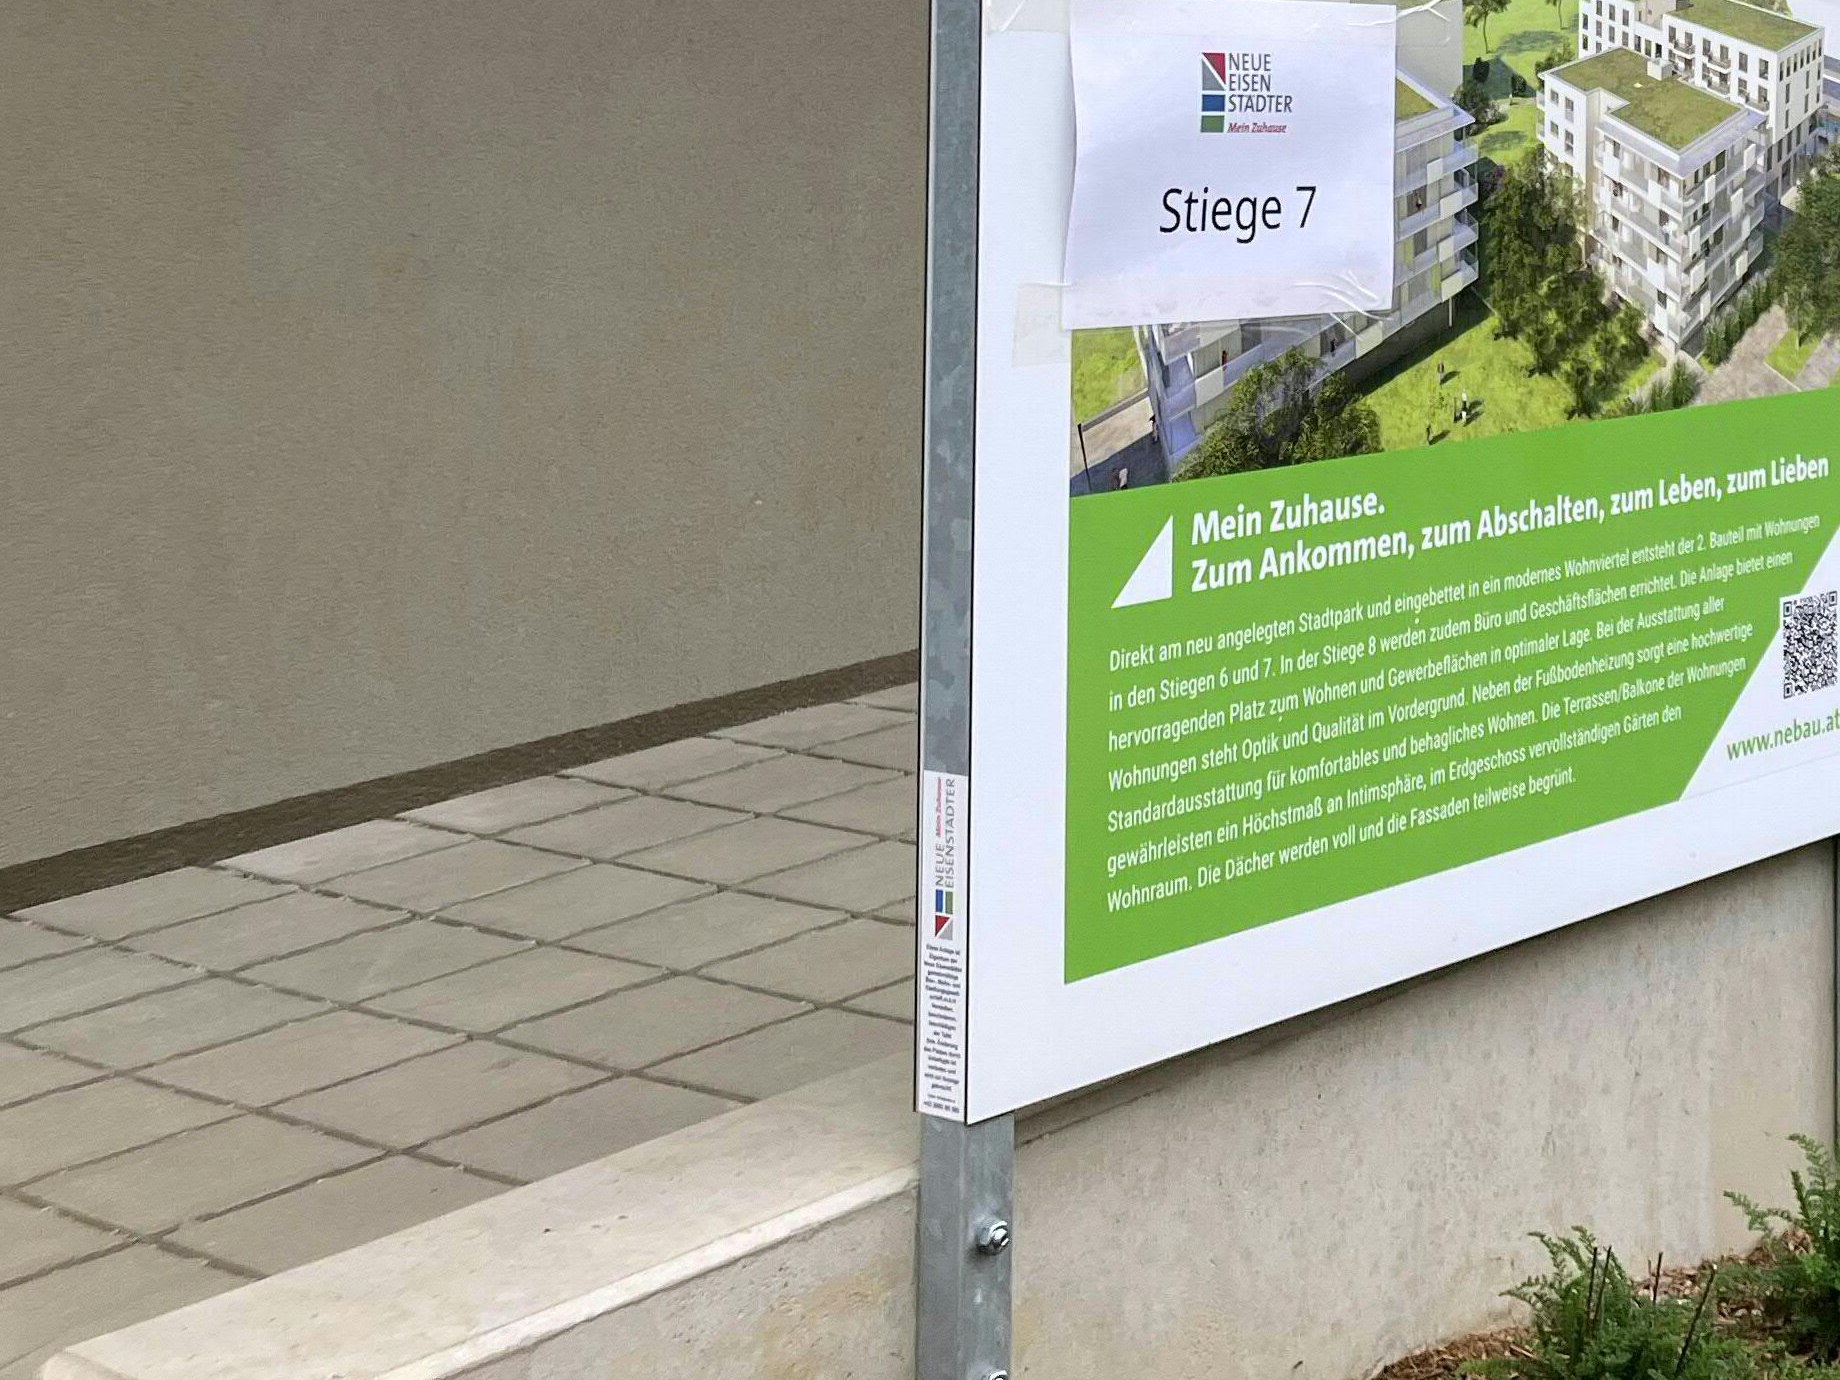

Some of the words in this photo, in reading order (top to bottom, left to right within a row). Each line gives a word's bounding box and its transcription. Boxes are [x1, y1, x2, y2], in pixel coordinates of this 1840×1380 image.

[1228, 53, 1271, 72] NEUE
[1228, 74, 1271, 92] EISEN
[1228, 95, 1293, 113] STÄDTER
[1159, 187, 1282, 244] Stiege
[1296, 185, 1317, 229] 7
[1191, 503, 1262, 545] Mein
[1269, 492, 1385, 532] Zuhause.
[1191, 558, 1252, 592] Zum
[1258, 531, 1415, 580] Ankommen,
[1421, 519, 1471, 550] zum
[1476, 495, 1605, 540] Abschalten,
[1610, 487, 1653, 515] zum
[1658, 475, 1722, 506] Leben,
[1726, 467, 1766, 494] zum
[1771, 456, 1829, 486] Lieben
[1109, 643, 1154, 671] Direkt
[1159, 642, 1182, 662] am
[1186, 636, 1213, 656] neu
[1217, 619, 1295, 651] angelegten
[1298, 601, 1364, 632] Stadtpark
[1366, 594, 1391, 618] und
[1394, 582, 1465, 614] eingebettet
[1468, 581, 1479, 597] in
[1482, 575, 1501, 595] ein
[1503, 565, 1561, 590] modernes
[1564, 548, 1630, 577] Wohnviertel
[1631, 540, 1675, 564] entsteht
[1677, 537, 1695, 555] der
[1709, 526, 1744, 549] Bauteil
[1746, 523, 1763, 541] mit
[1764, 514, 1820, 537] Wohnungen
[1109, 693, 1123, 711] in
[1127, 685, 1155, 708] den
[1160, 674, 1215, 700] Stiegen
[1219, 667, 1228, 688] 6
[1232, 659, 1259, 684] und
[1280, 655, 1293, 674] In
[1296, 649, 1320, 671] der
[1322, 642, 1365, 665] Stiege
[1368, 635, 1376, 656] 8
[1379, 627, 1426, 652] werden
[1429, 618, 1471, 642] zudem
[1474, 611, 1502, 632] Büro
[1504, 603, 1527, 625] und
[1529, 584, 1627, 620] Geschäftsflächen
[1629, 574, 1677, 598] errichtet.
[1680, 569, 1697, 587] Die
[1698, 563, 1735, 583] Anlage
[1736, 555, 1764, 575] bietet
[1766, 551, 1793, 568] einen
[1108, 708, 1225, 751] hervorragenden
[1229, 700, 1266, 723] Platz
[1269, 693, 1299, 715] zum
[1302, 680, 1356, 707] Wohnen
[1360, 669, 1384, 694] und
[1388, 650, 1487, 687] Gewerbeflächen
[1490, 648, 1502, 664] in
[1504, 632, 1560, 663] optimaler
[1562, 627, 1593, 648] Lage.
[1596, 620, 1614, 639] Bei
[1616, 615, 1635, 634] der
[1636, 603, 1701, 629] Ausstattung
[1702, 595, 1725, 615] aller
[1108, 755, 1196, 792] Wohnungen
[1201, 743, 1238, 769] steht
[1241, 732, 1279, 762] Optik
[1282, 724, 1308, 750] und
[1312, 713, 1364, 743] Qualität
[1367, 710, 1384, 728] im
[1387, 687, 1468, 723] Vordergrund.
[1472, 680, 1510, 704] Neben
[1513, 674, 1533, 693] der
[1535, 651, 1634, 688] Fußbodenheizung
[1636, 641, 1664, 663] sorgt
[1666, 638, 1689, 656] eine
[1690, 623, 1753, 649] hochwertige
[1727, 708, 1840, 761] www.nebau.at
[1107, 779, 1262, 832] Standardausstattung
[1266, 769, 1286, 791] für
[1289, 747, 1379, 786] komfortables
[1382, 737, 1407, 762] und
[1410, 722, 1484, 755] behagliches
[1487, 709, 1538, 734] Wohnen.
[1541, 701, 1560, 721] Die
[1563, 677, 1665, 714] Terrassen/Balkone
[1666, 672, 1684, 689] der
[1686, 657, 1746, 683] Wohnungen
[1107, 830, 1212, 877] gewährleisten
[1216, 821, 1238, 843] ein
[1242, 795, 1323, 836] Höchstmaß
[1326, 795, 1343, 814] an
[1346, 773, 1426, 808] Intimsphäre,
[1430, 768, 1445, 786] im
[1449, 747, 1526, 781] Erdgeschoss
[1528, 721, 1621, 758] vervollständigen
[1623, 711, 1659, 733] Gärten
[1661, 705, 1681, 723] den
[935, 844, 944, 886] NEUE
[1107, 875, 1192, 912] Wohnraum.
[1197, 864, 1221, 887] Die
[1225, 851, 1275, 880] Dächer
[1278, 836, 1328, 865] werden
[1332, 824, 1355, 849] voll
[1359, 816, 1383, 842] und
[1386, 813, 1407, 834] die
[1410, 797, 1470, 828] Fassaden
[1473, 782, 1526, 810] teilweise
[1528, 766, 1575, 795] begrünt.
